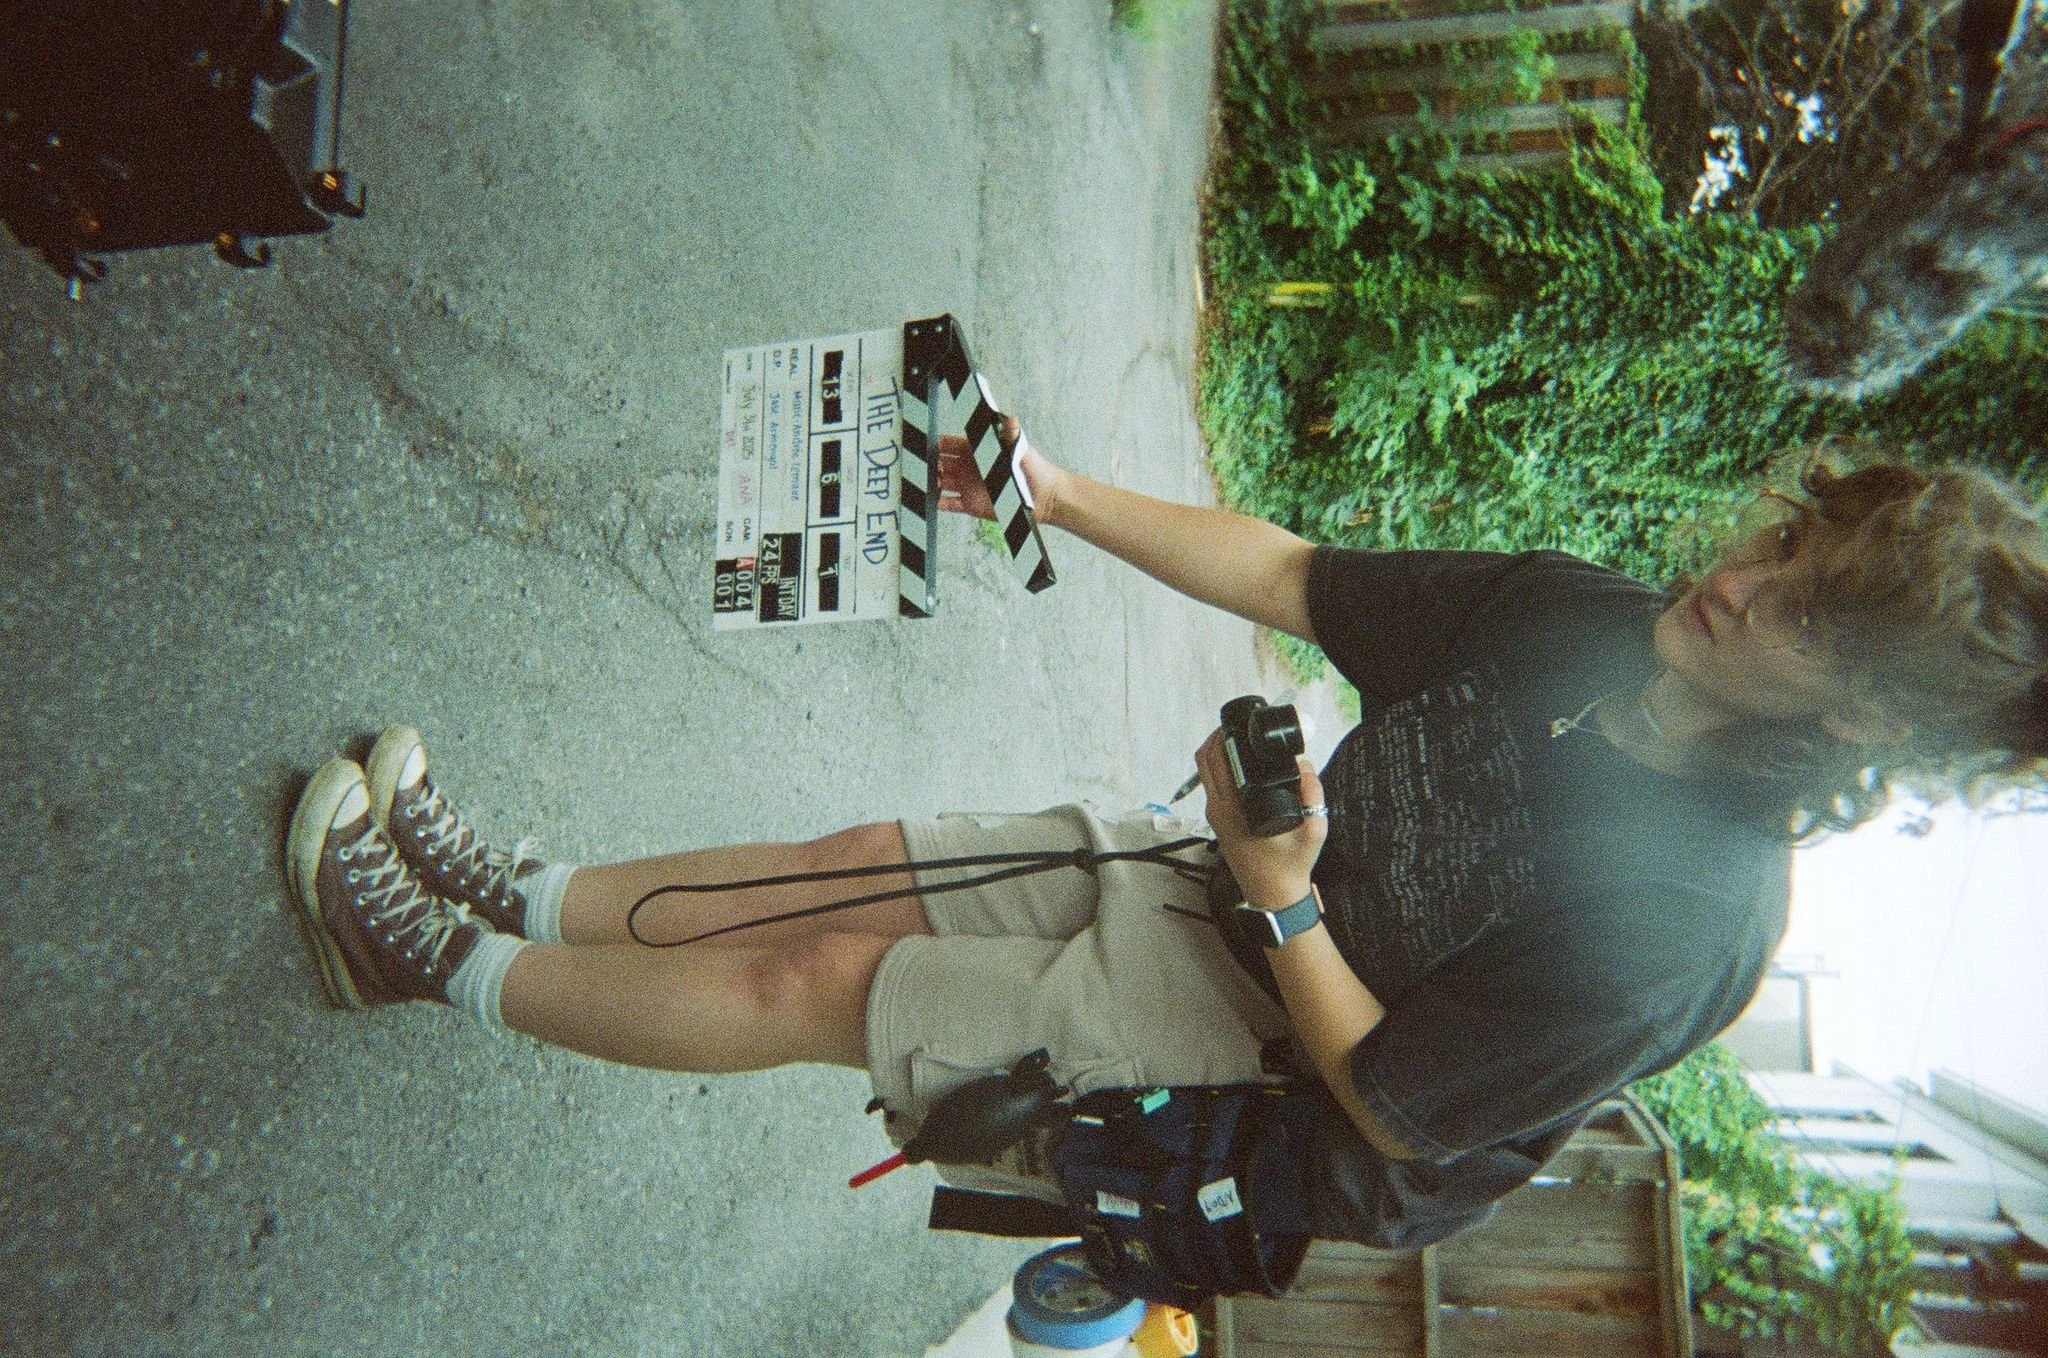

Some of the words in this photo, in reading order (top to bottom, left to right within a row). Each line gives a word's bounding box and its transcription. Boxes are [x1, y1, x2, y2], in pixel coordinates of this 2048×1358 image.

[822, 376, 839, 400] 13
[867, 377, 902, 434] THE
[822, 472, 838, 484] 6
[863, 441, 899, 500] DEEP
[762, 538, 779, 561] 24
[863, 511, 899, 565] END
[761, 565, 778, 584] FPS
[819, 566, 836, 577] 1
[716, 573, 732, 608] 001
[778, 577, 796, 595] INT
[778, 597, 795, 617] DAY
